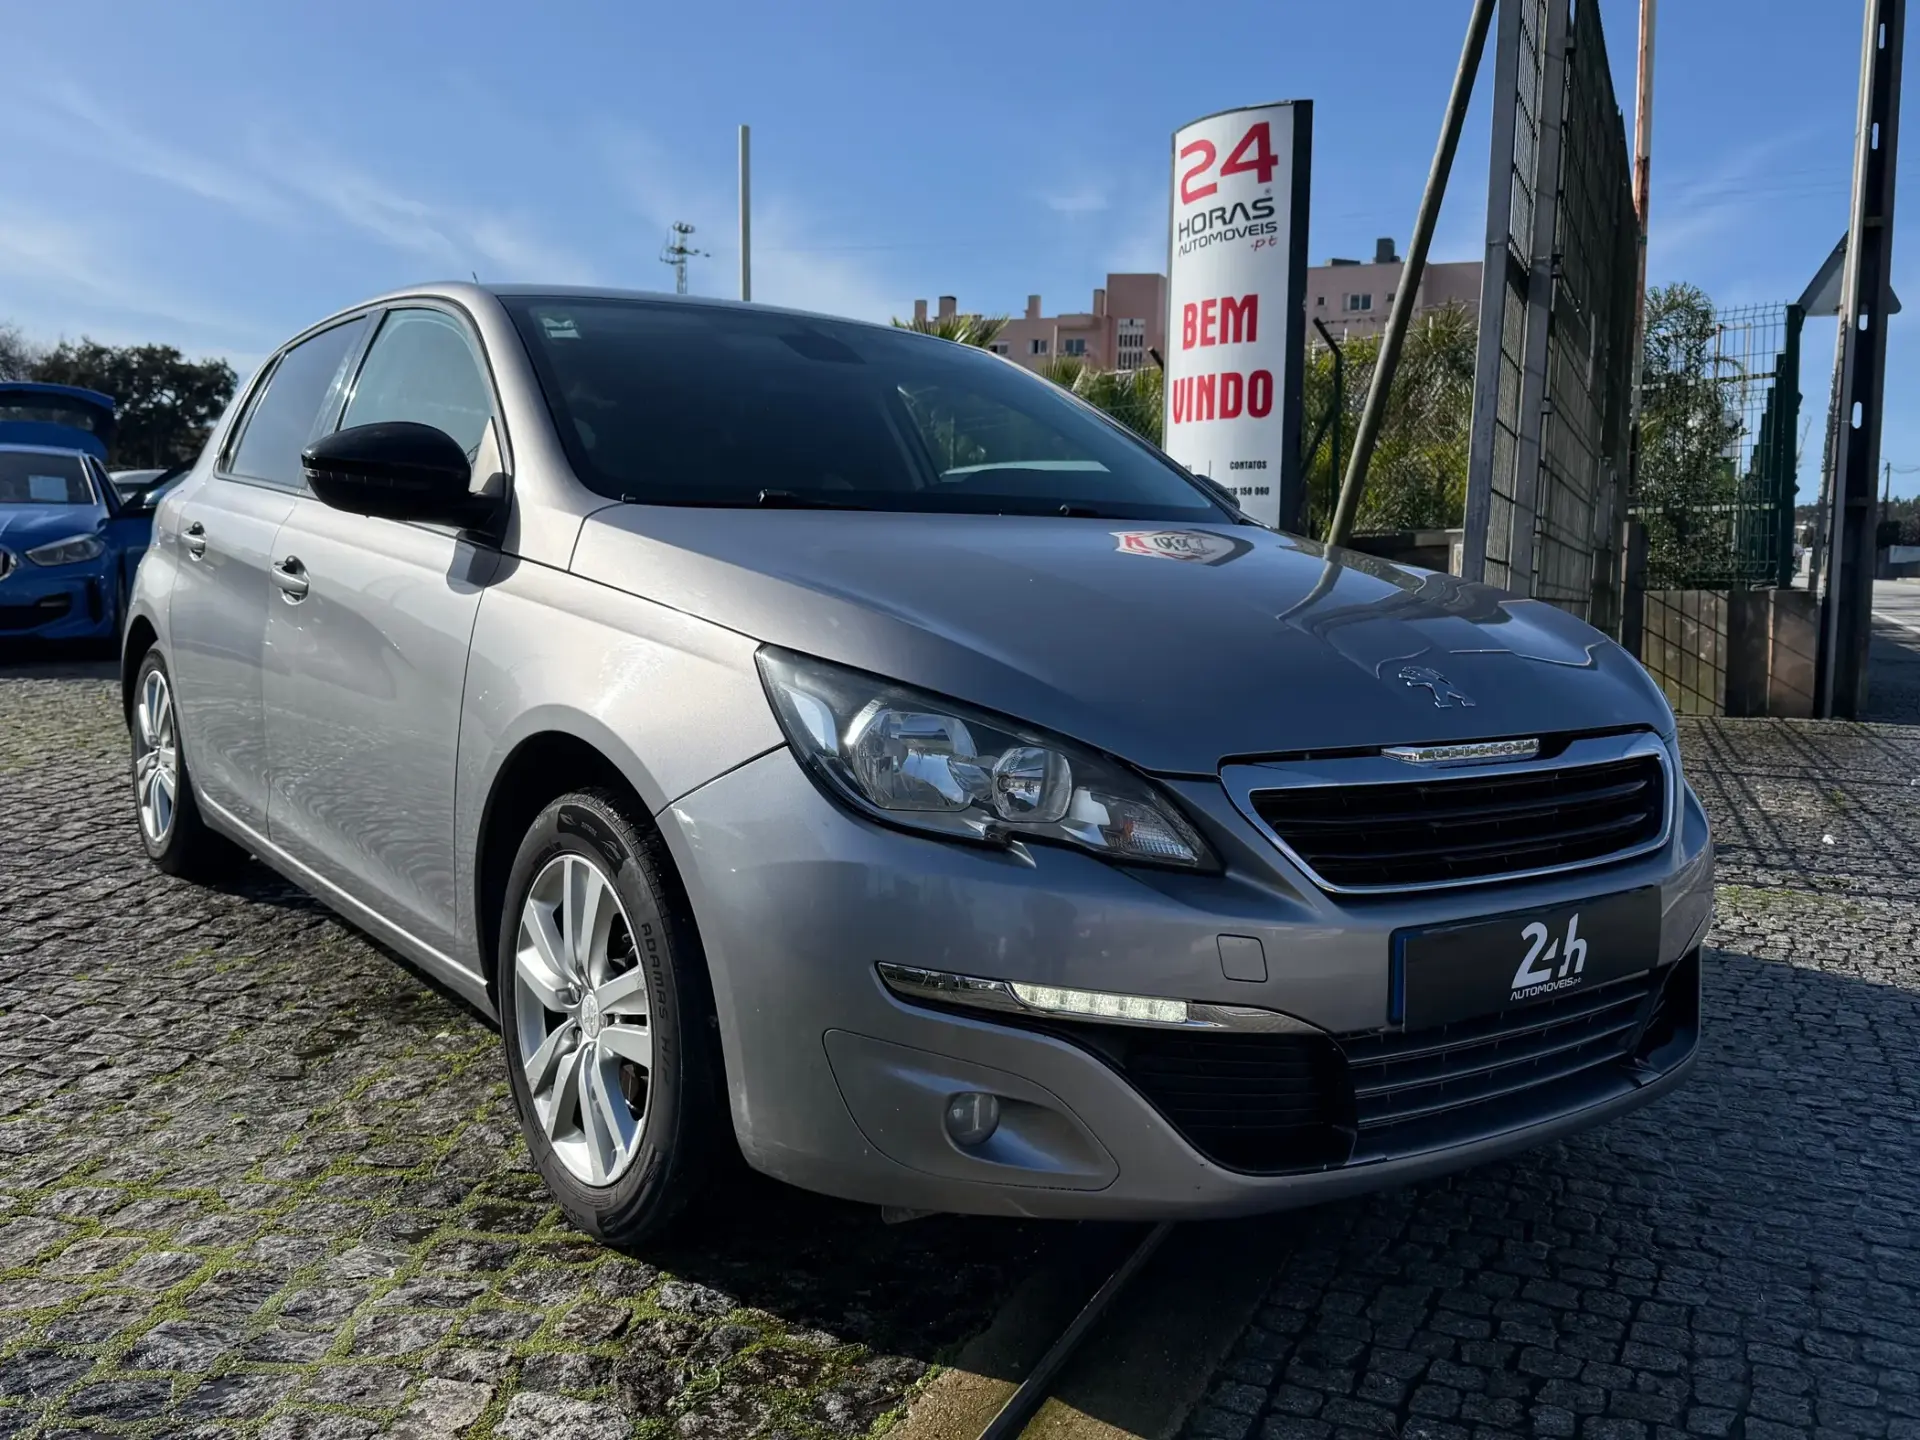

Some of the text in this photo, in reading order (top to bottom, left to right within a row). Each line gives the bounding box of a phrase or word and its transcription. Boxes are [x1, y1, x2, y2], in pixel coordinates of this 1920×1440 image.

[1180, 121, 1279, 206] 24
[1178, 221, 1278, 257] AUTOMOVEIS
[1179, 196, 1275, 242] HORAS
[1182, 293, 1259, 350] BEM
[1172, 369, 1273, 424] VINDO
[1229, 460, 1267, 470] CONTATOS
[641, 922, 669, 1020] ADAMAS
[1511, 912, 1588, 989] 24h
